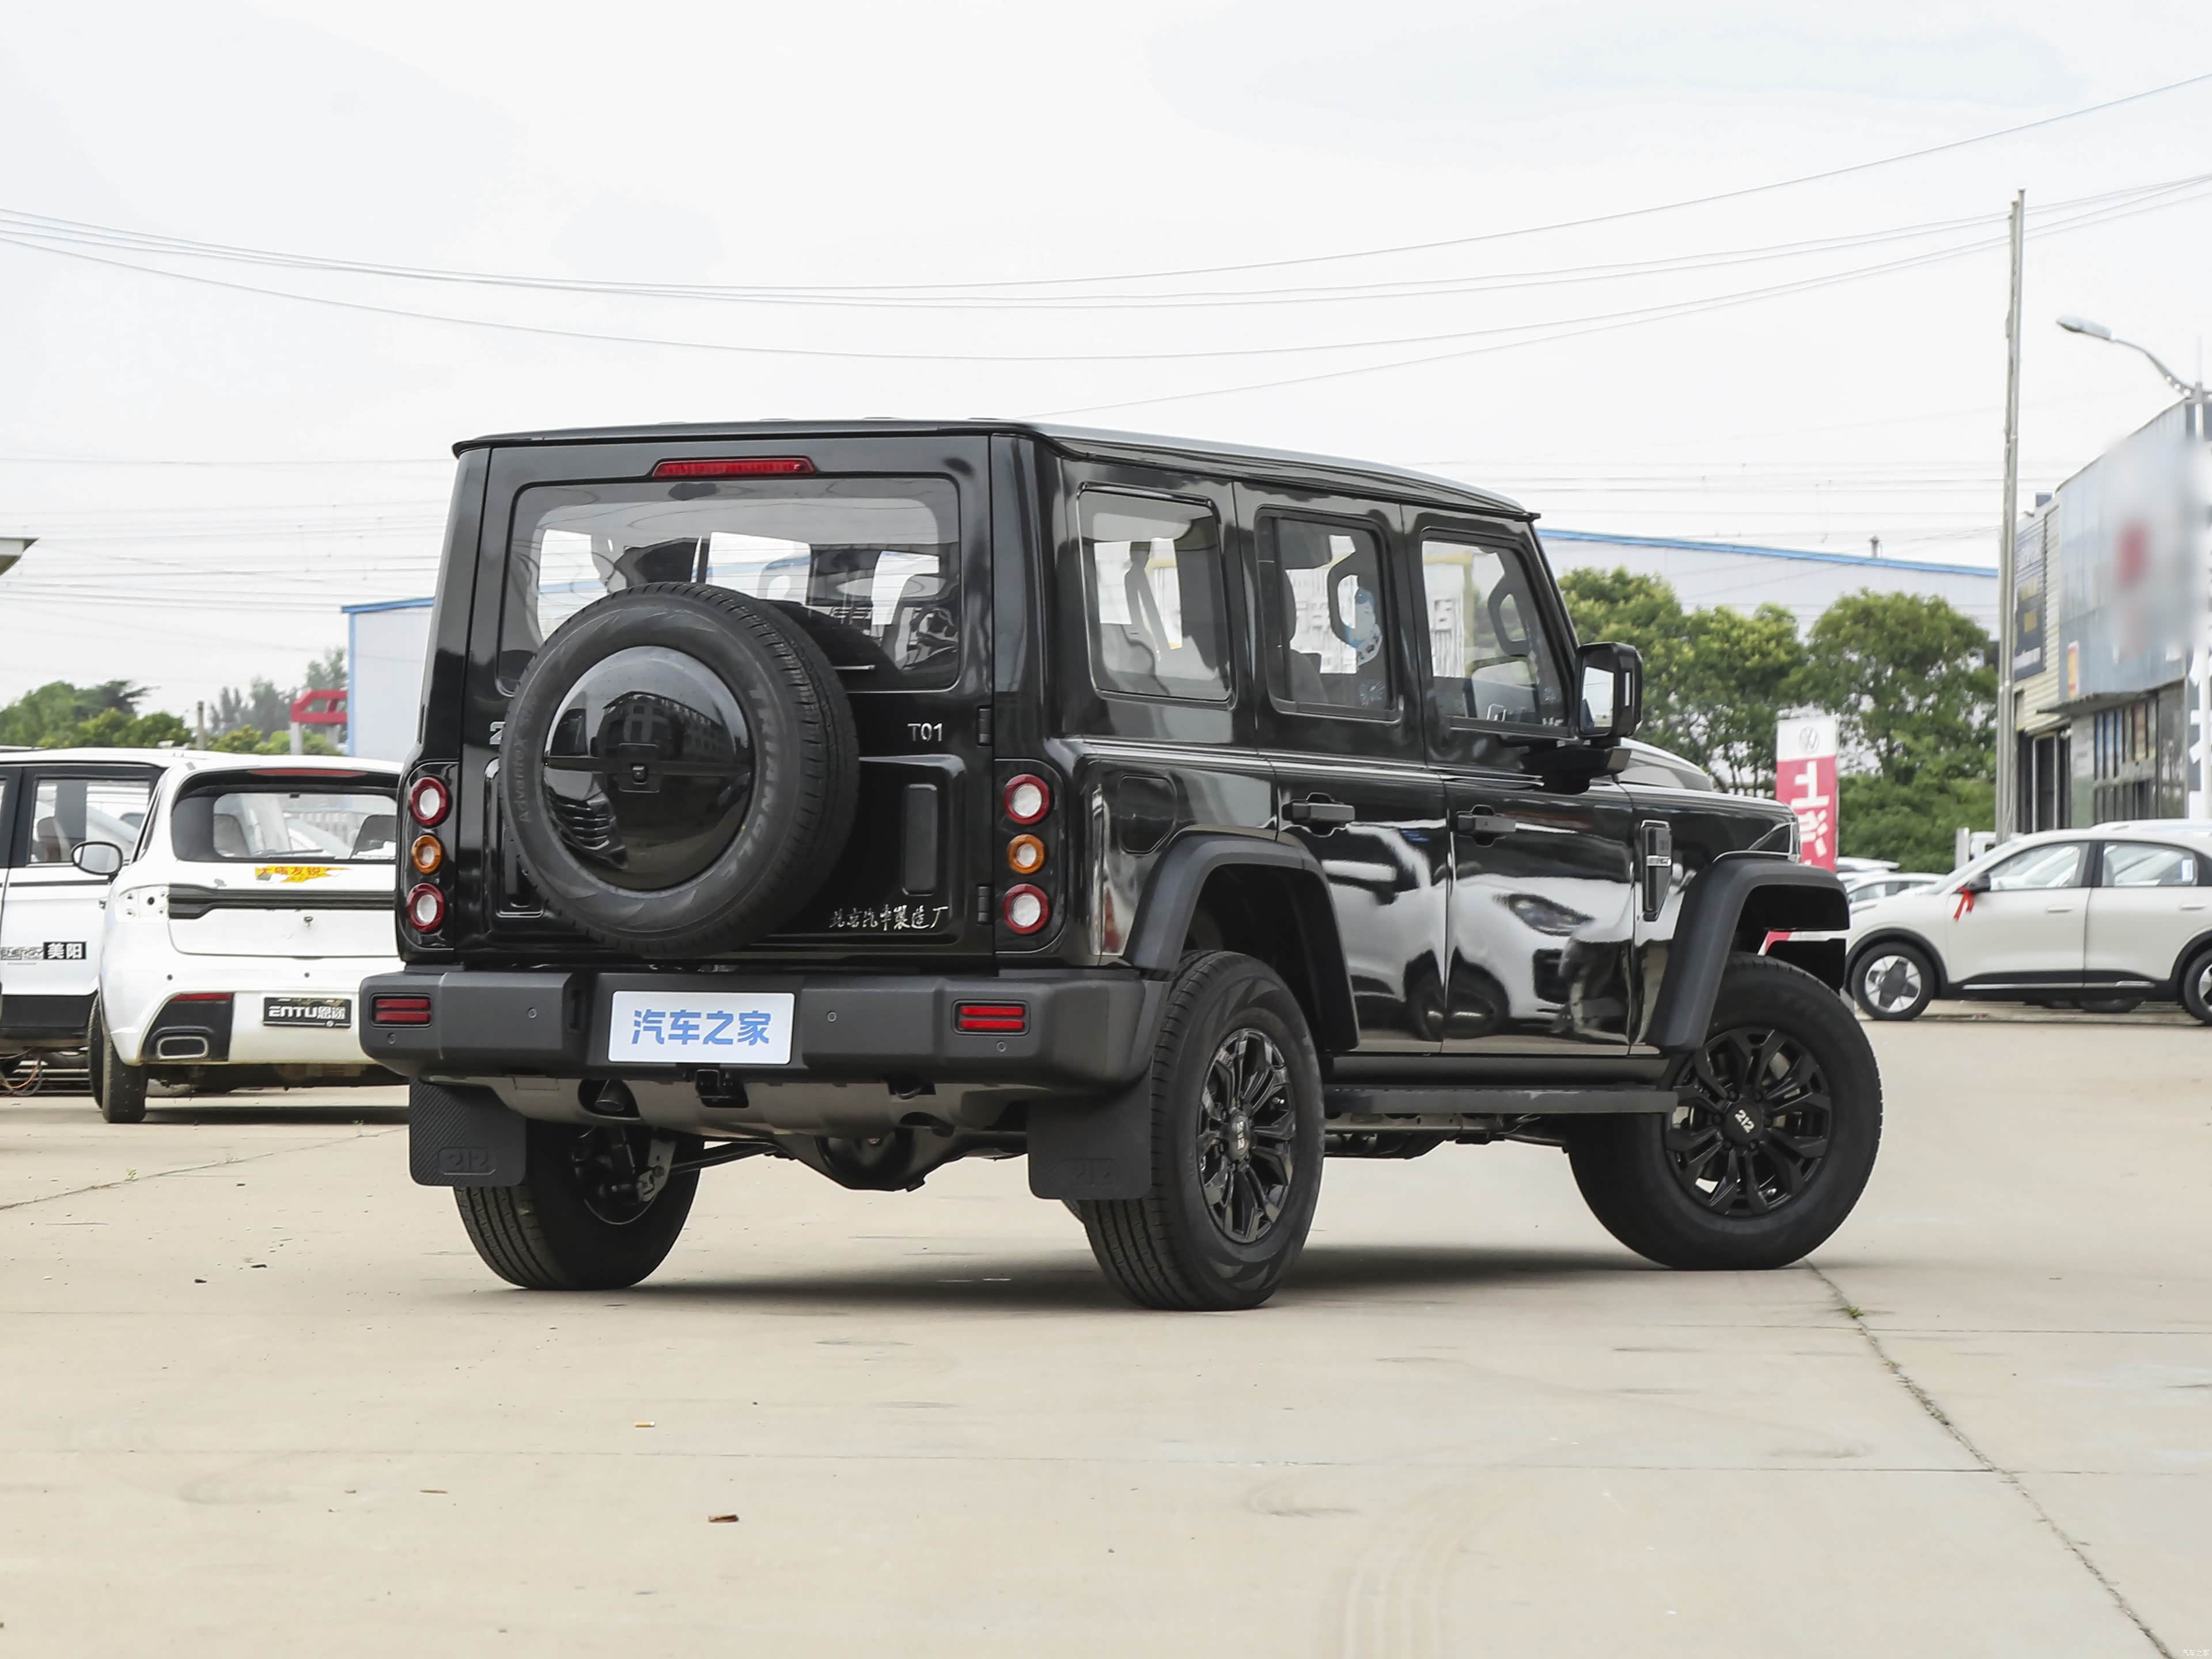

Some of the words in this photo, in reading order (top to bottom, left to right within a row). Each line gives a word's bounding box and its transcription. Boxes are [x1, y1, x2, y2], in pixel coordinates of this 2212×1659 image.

[907, 723, 942, 741] T01
[47, 943, 82, 959] 美阳
[631, 1009, 771, 1046] 汽车之家
[1734, 1109, 1755, 1134] 212
